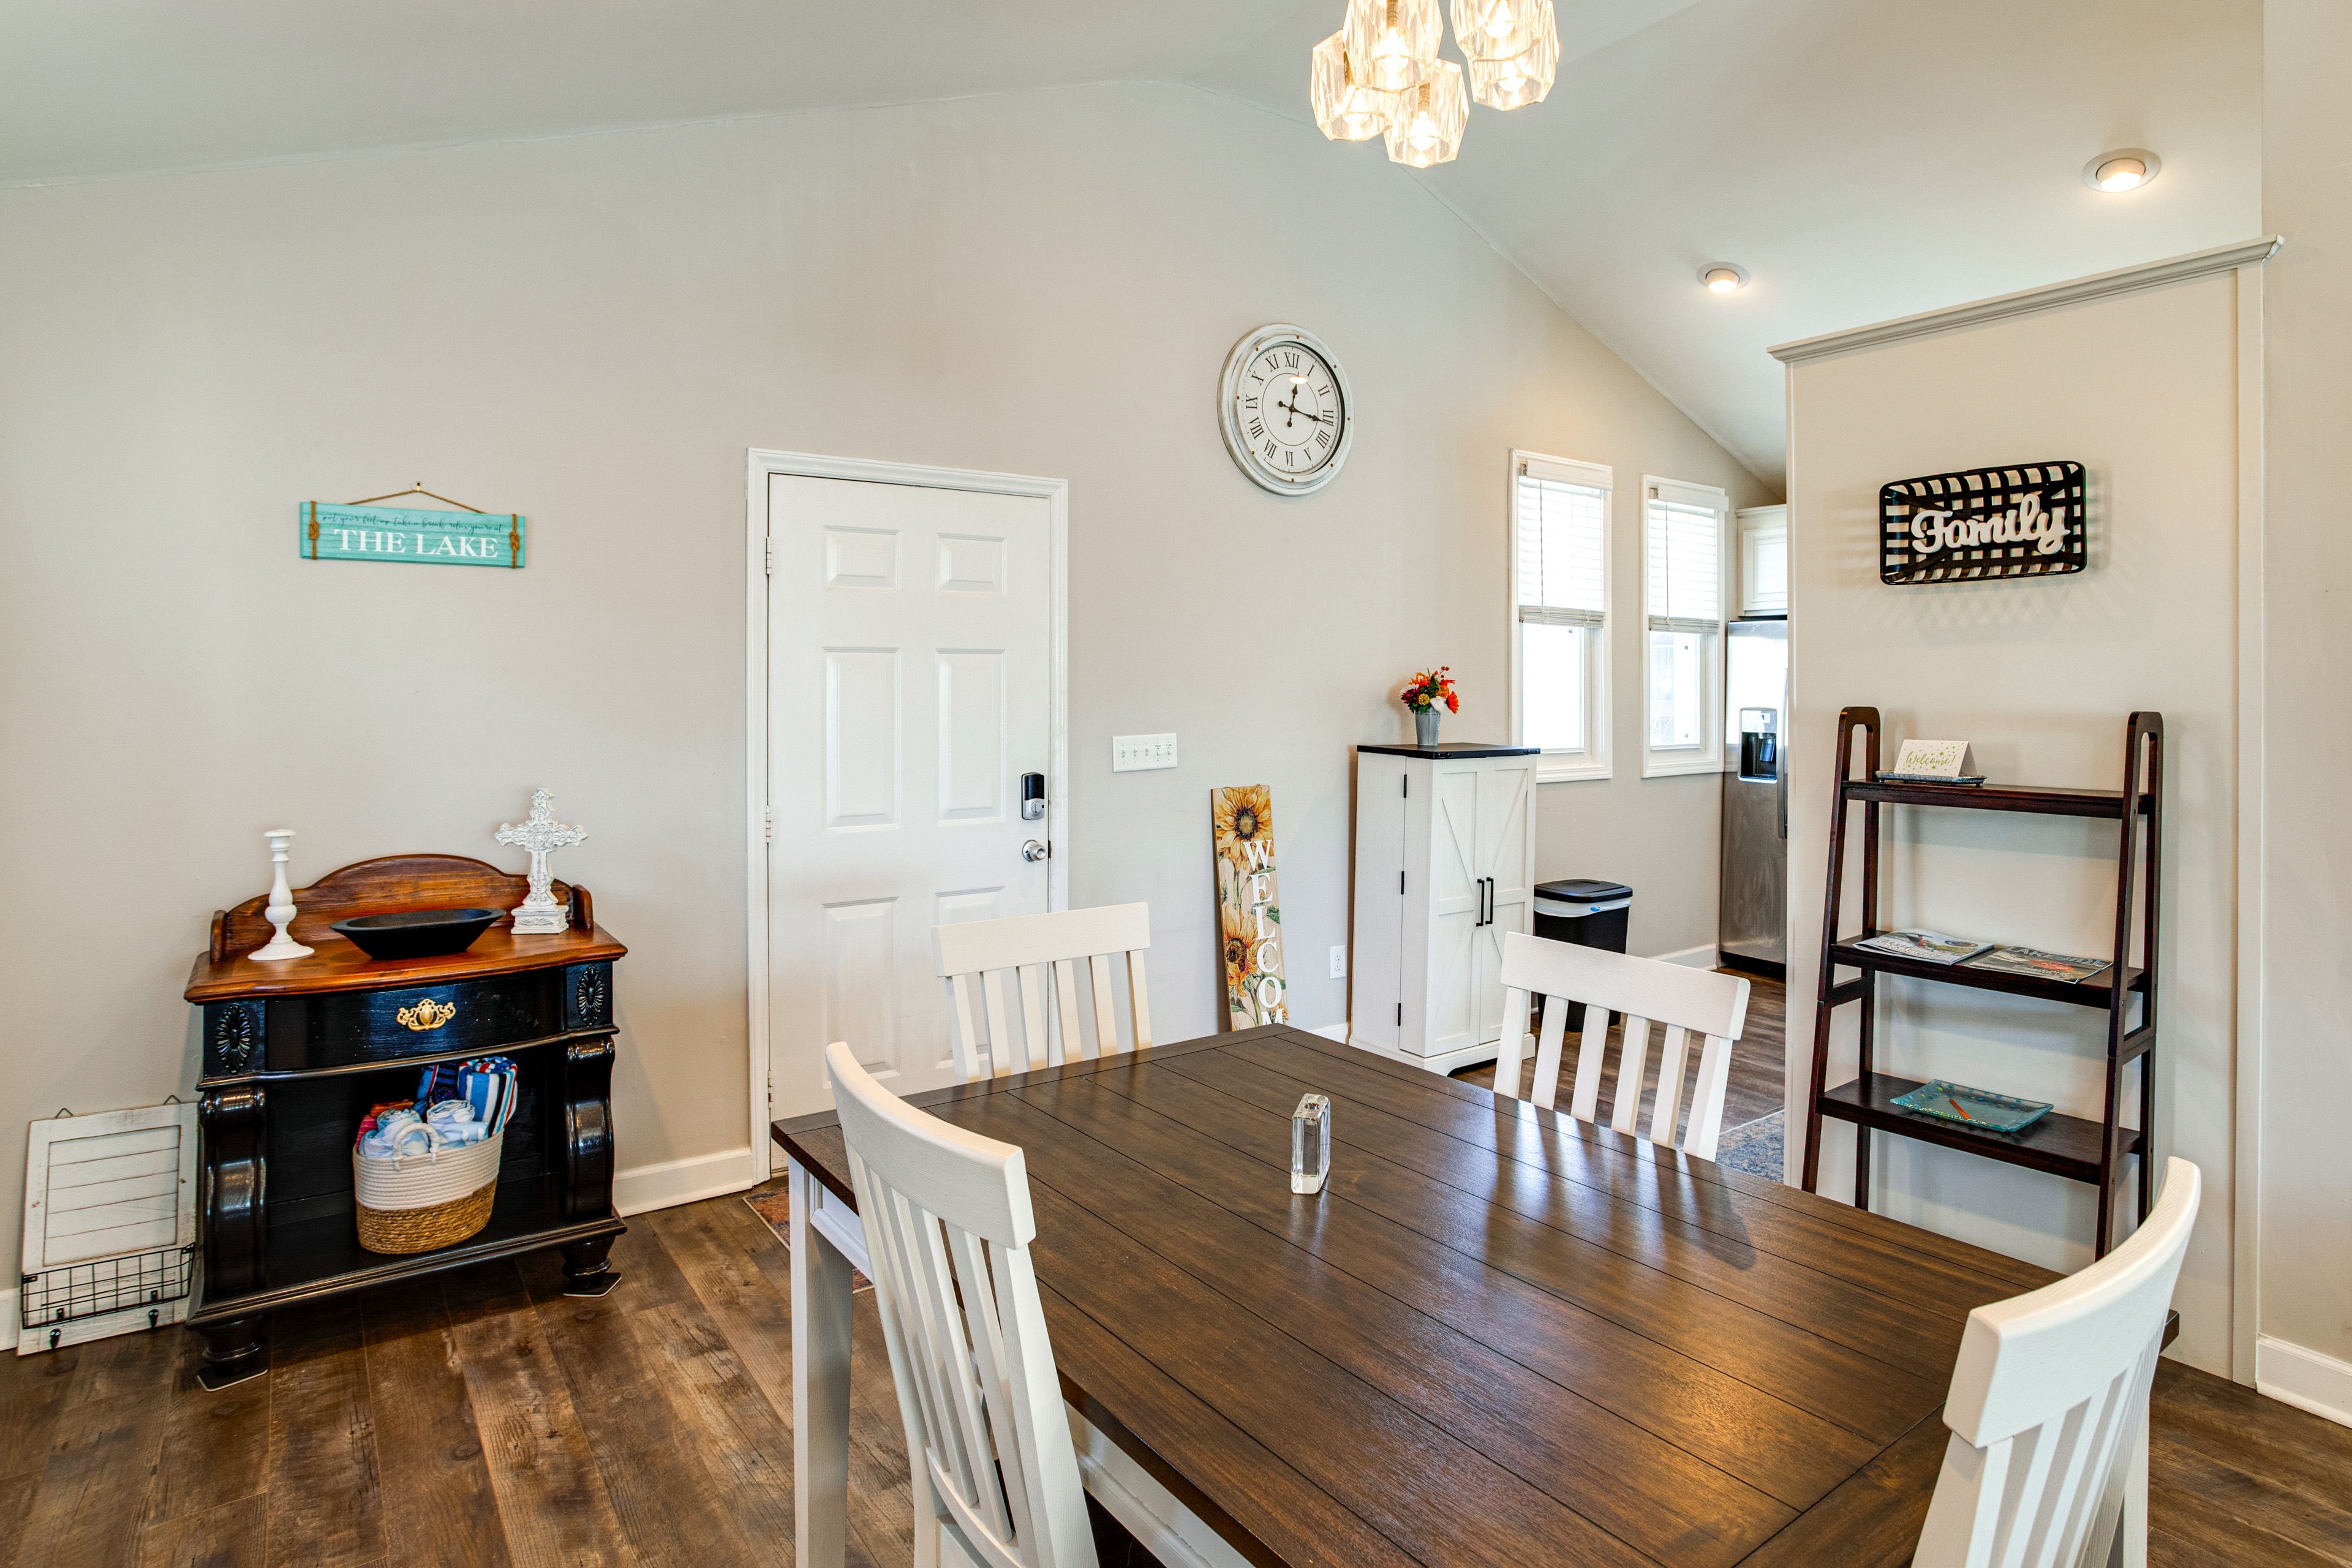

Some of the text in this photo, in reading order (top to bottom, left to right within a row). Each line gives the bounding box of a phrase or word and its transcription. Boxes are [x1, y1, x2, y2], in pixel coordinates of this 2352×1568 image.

[1265, 353, 1280, 372] XI
[1284, 352, 1300, 369] XII
[1251, 371, 1265, 386] X
[1306, 364, 1315, 377] I
[1317, 384, 1331, 397] II
[1246, 394, 1258, 410] IX
[1322, 409, 1334, 427] III
[1248, 417, 1265, 440] VIII
[1264, 439, 1278, 459] VII
[1303, 447, 1313, 462] V
[1285, 451, 1294, 467] VI
[340, 516, 359, 528] your
[363, 513, 377, 525] feet
[394, 515, 411, 526] take
[421, 517, 445, 529] break
[449, 521, 468, 530] relax
[470, 524, 491, 535] you're
[494, 524, 502, 533] at
[1911, 493, 2071, 555] Family
[333, 529, 499, 558] THE LAKE
[1905, 751, 1956, 766] Welcome!
[2005, 946, 2107, 968] LAKESIDE
